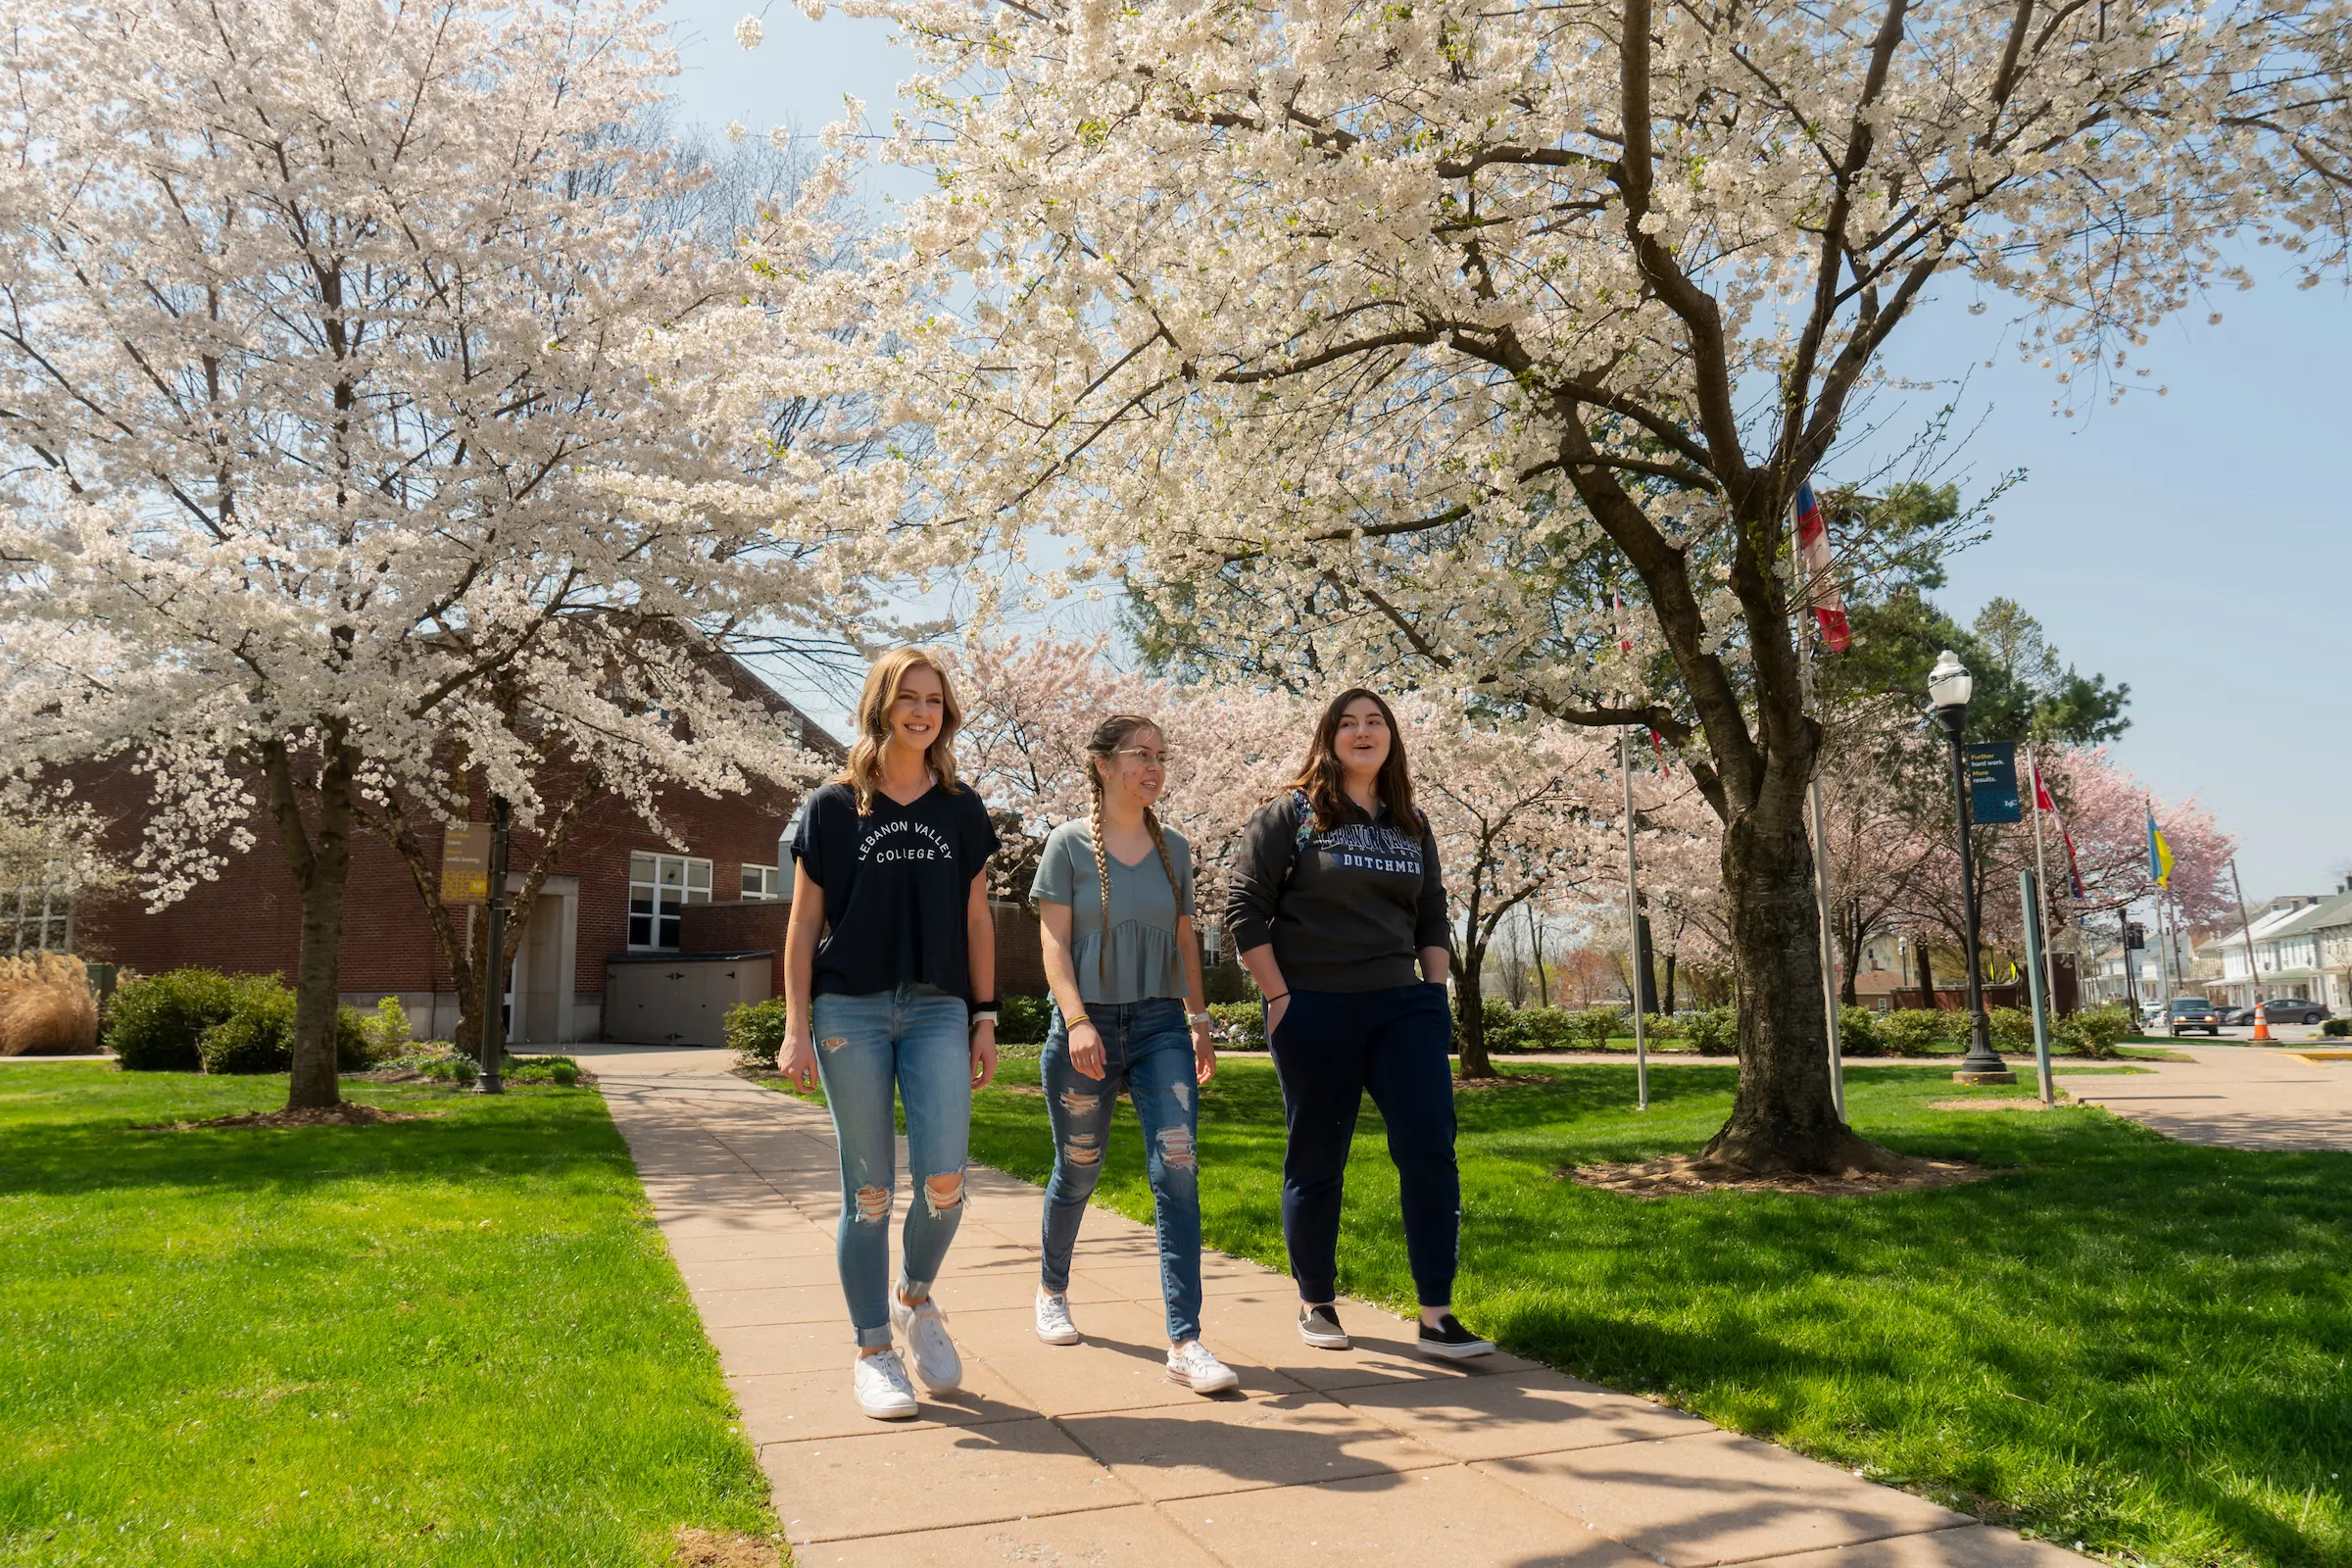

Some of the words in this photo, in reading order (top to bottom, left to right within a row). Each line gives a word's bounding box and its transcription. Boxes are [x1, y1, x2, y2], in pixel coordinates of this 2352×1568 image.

[858, 821, 907, 861] LEBANON
[914, 822, 953, 860] VALLEY
[876, 849, 935, 863] COLLEGE
[1344, 854, 1421, 875] DUTCHMEN
